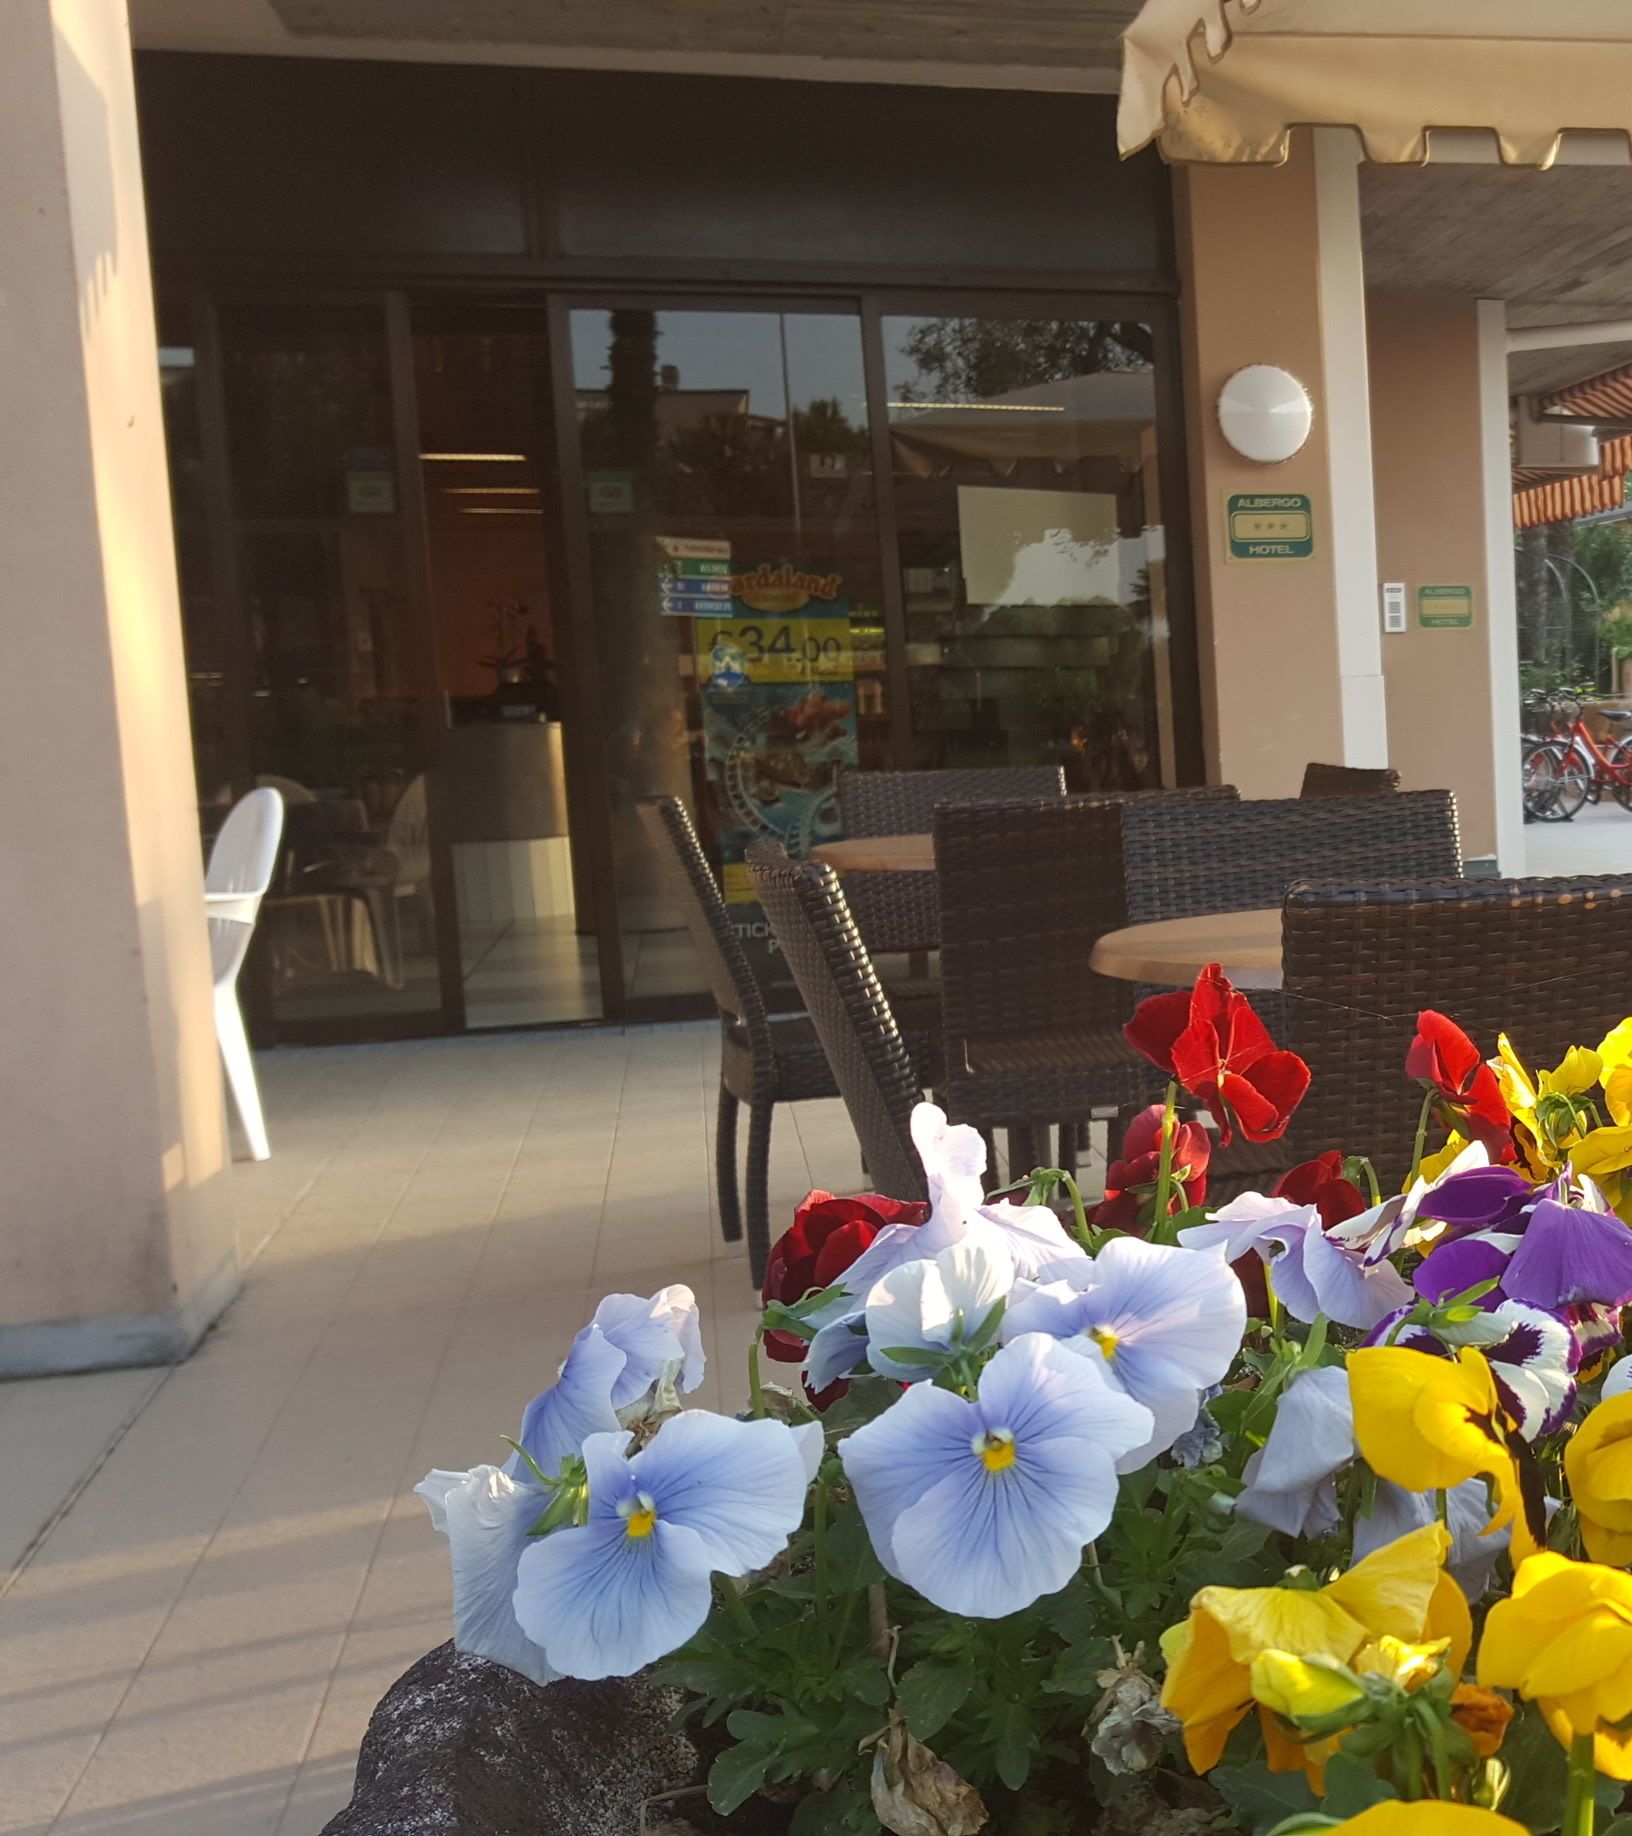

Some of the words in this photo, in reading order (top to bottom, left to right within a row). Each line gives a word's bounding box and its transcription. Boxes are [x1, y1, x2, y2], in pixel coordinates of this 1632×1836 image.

[1237, 497, 1302, 508] ALBERGO
[1248, 544, 1295, 555] HOTEL
[728, 563, 841, 600] ardaland
